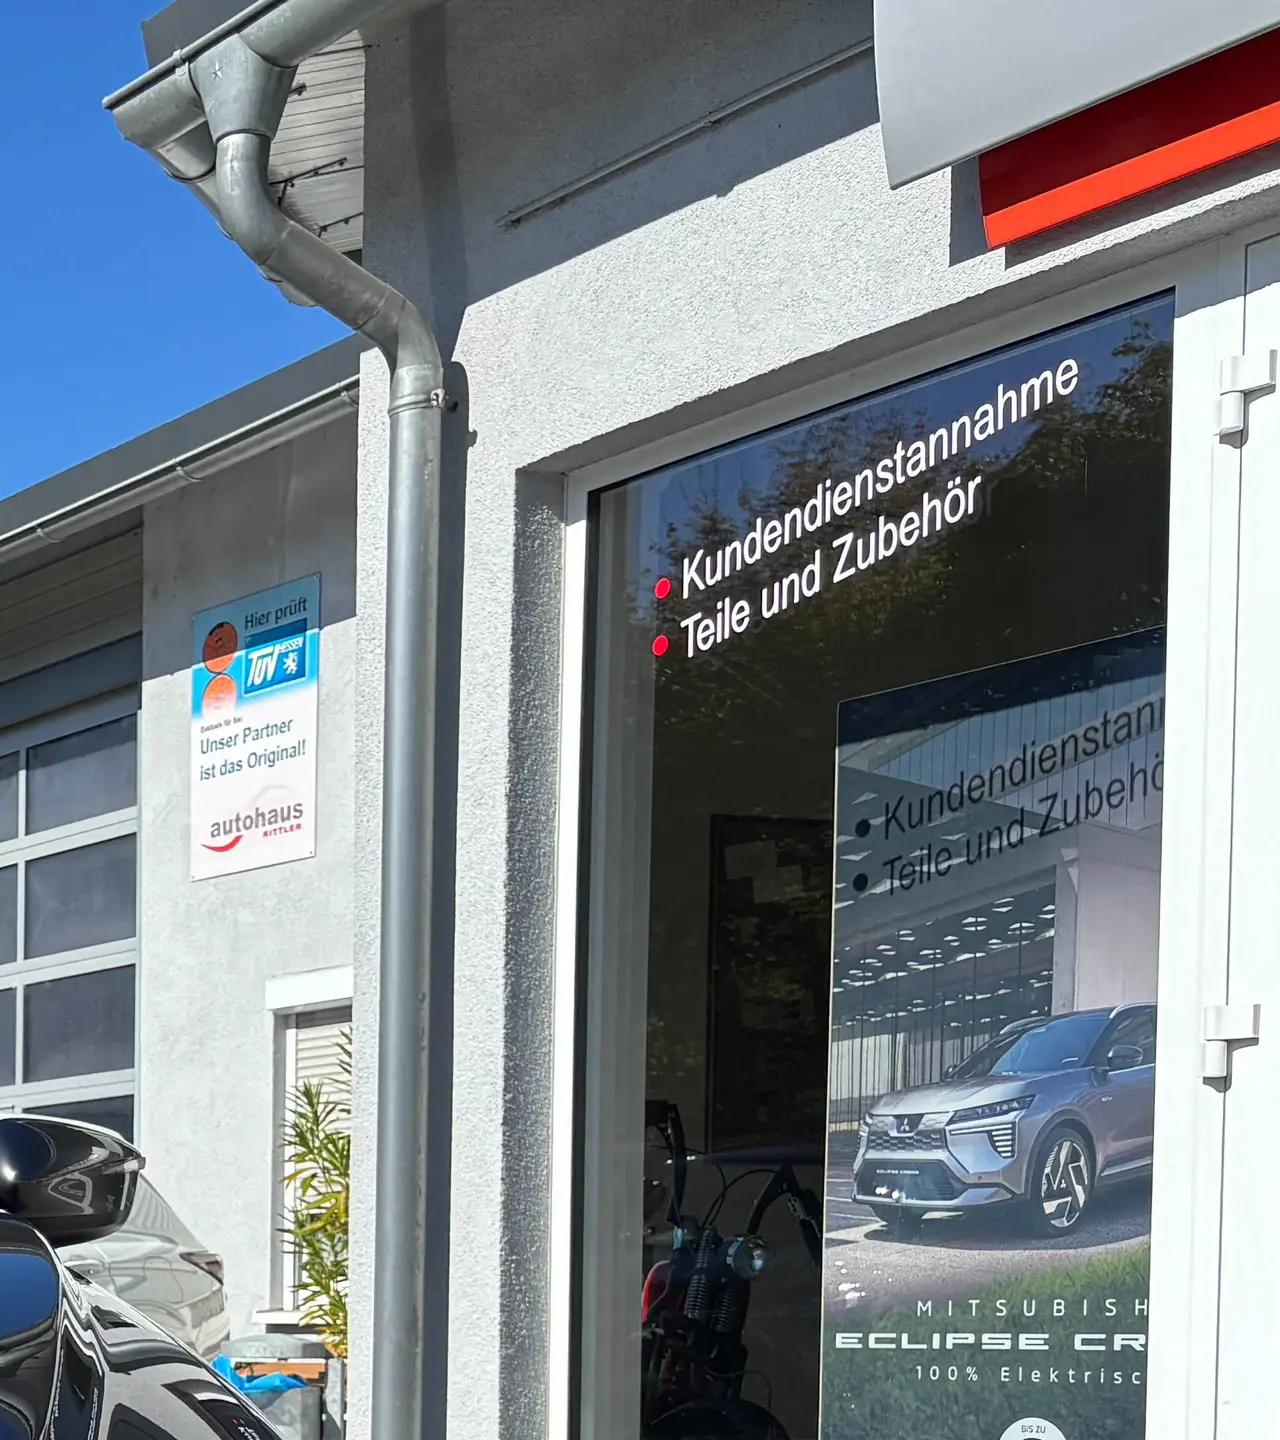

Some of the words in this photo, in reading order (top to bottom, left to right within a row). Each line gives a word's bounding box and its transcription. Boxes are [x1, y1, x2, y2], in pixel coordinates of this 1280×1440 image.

[681, 358, 1080, 600] Kundendienstannahme
[680, 598, 750, 659] Teile
[762, 550, 821, 620] und
[833, 475, 982, 584] Zubehör
[244, 612, 272, 630] Hier
[274, 597, 307, 624] prüft
[200, 733, 239, 754] Unser
[243, 719, 294, 744] Partner
[200, 763, 216, 781] ist
[220, 759, 243, 776] das
[247, 739, 306, 768] Original!
[210, 802, 304, 838] autohaus
[835, 1332, 1050, 1350] ECLIPSE
[1074, 1333, 1146, 1351] CR
[915, 1365, 979, 1382] 100%
[1000, 1367, 1141, 1384] Elektrisc
[1021, 1425, 1034, 1433] BIS
[1035, 1425, 1046, 1433] ZU
